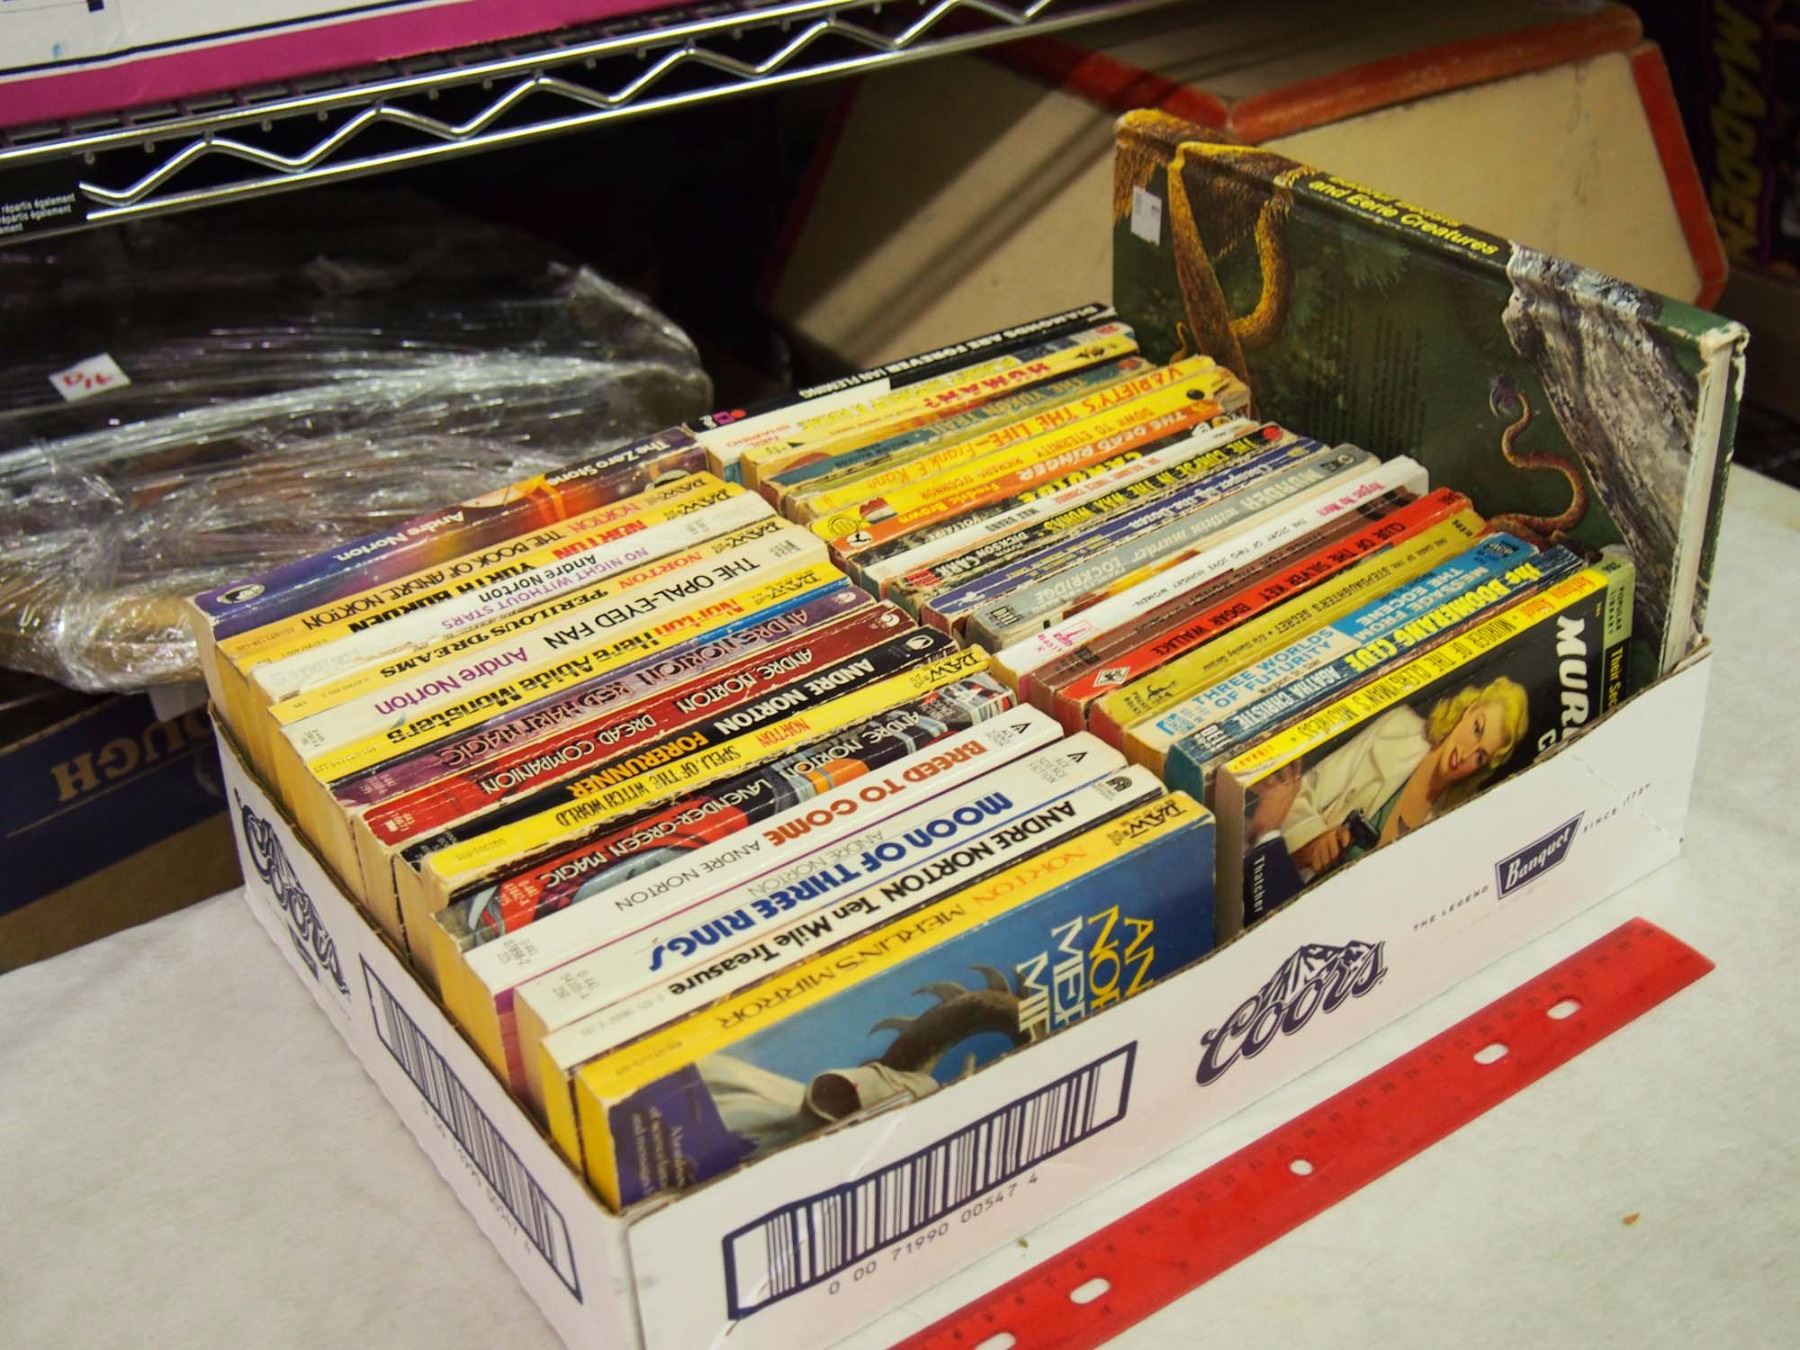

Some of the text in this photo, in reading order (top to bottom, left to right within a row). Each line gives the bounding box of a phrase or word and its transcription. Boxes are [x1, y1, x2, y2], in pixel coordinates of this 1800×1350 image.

[1307, 178, 1347, 199] and
[1345, 192, 1399, 219] Eerie
[1399, 211, 1500, 256] Creatures
[1001, 301, 1098, 341] DIAMONDS
[885, 341, 967, 375] FOREVER
[967, 332, 1002, 350] ARE
[798, 372, 859, 400] FLEMING
[922, 359, 1050, 410] HUMAN?
[929, 410, 981, 436] TRAIL
[1033, 407, 1071, 430] THE
[593, 448, 636, 472] Zero
[634, 436, 669, 457] The
[1034, 430, 1090, 458] ETERNITY
[1228, 436, 1256, 455] THE
[545, 461, 594, 489] Stone
[1015, 446, 1094, 482] RINGER
[1015, 449, 1145, 503] CANDIDE
[1156, 470, 1173, 485] IN
[1092, 491, 1127, 513] WAX
[1126, 479, 1155, 498] THE
[1238, 466, 1322, 512] MURDER
[406, 509, 464, 539] Andre
[569, 499, 640, 534] NORTON
[897, 499, 947, 527] Brown
[469, 540, 525, 570] BOOK
[525, 526, 564, 549] THE
[551, 516, 647, 562] NORTON
[974, 530, 1028, 558] DICKSON
[1128, 529, 1189, 563] murder
[1351, 537, 1374, 554] OF
[444, 560, 473, 579] OF
[617, 550, 703, 589] NORTON
[711, 554, 759, 582] THE
[934, 552, 980, 580] CARR
[1282, 559, 1331, 589] SILVER
[1325, 546, 1355, 567] THE
[1501, 560, 1542, 589] the
[383, 569, 446, 601] ANDRE
[440, 546, 648, 630] NO NIGHT WITHOUT STARS
[477, 552, 597, 605] Andre Norton
[1031, 556, 1123, 603] LOCKRIDGE
[1257, 582, 1286, 602] KEY
[1404, 566, 1489, 614] MESSAGE
[1424, 564, 1464, 589] THE
[300, 591, 381, 632] NORTON
[347, 587, 451, 635] BURDEN
[489, 585, 608, 638] PERILOUS
[591, 572, 715, 630] OPAL-EYED
[652, 596, 744, 642] Norton
[1206, 600, 1252, 629] EDGAR
[1353, 586, 1427, 627] EOCENE
[1389, 579, 1508, 647] BOOMERANG
[542, 620, 595, 650] FAN
[1271, 607, 1312, 633] SECRET
[1351, 607, 1409, 642] FROM
[378, 628, 488, 681] DREAMS
[591, 630, 658, 667] Here
[1149, 624, 1207, 657] WALLACE
[1342, 637, 1397, 673] CLUE
[457, 645, 529, 685] Andre
[517, 656, 593, 696] Abide
[925, 651, 978, 682] DAW
[1192, 628, 1334, 705] THREE WORLDS
[1214, 640, 1333, 708] OF FUTURITY
[1294, 615, 1518, 742] MURDER OF THE CLERGYMAN'S MISTRESS
[1608, 646, 1624, 706] Their Sec
[373, 674, 459, 719] Norton
[437, 607, 809, 767] ANDRE NORTON RED HART MAGIC
[1286, 666, 1341, 701] AGATHA
[385, 683, 521, 749] Monsters
[478, 647, 814, 795] ANDRE NORTON DREAD COMPANION
[570, 658, 874, 799] ANDRE NORTON FORERUNNER
[1231, 692, 1292, 730] CHRISTIE
[754, 716, 810, 748] NORTON
[1201, 725, 1234, 752] DELL
[647, 767, 680, 791] THE
[678, 760, 699, 778] OF
[899, 737, 989, 787] BREED
[537, 711, 922, 888] ANDRE NORTON LAVENDER-GREEN MAGIC
[602, 779, 650, 809] WITCH
[856, 774, 906, 806] TO
[554, 796, 606, 828] WORLD
[761, 795, 859, 848] COME
[1122, 804, 1188, 836] DAW
[698, 839, 761, 874] ANDRE
[746, 829, 884, 897] ANDRE NORTON
[612, 867, 699, 913] NORTON
[642, 789, 1014, 970] MOON OF THREE RINGS
[968, 843, 1089, 907] NORTON
[1252, 854, 1267, 914] Thatcher
[1413, 828, 1572, 933] THE LEGEND Banquet
[667, 800, 1077, 1000] ANDRE NORTON Ten Mile Treasure
[1123, 915, 1156, 994] AN
[715, 967, 836, 1029] MIRROR
[1196, 940, 1388, 1088] Coors
[828, 1171, 1041, 1297] 0 00 71990 00547 4
